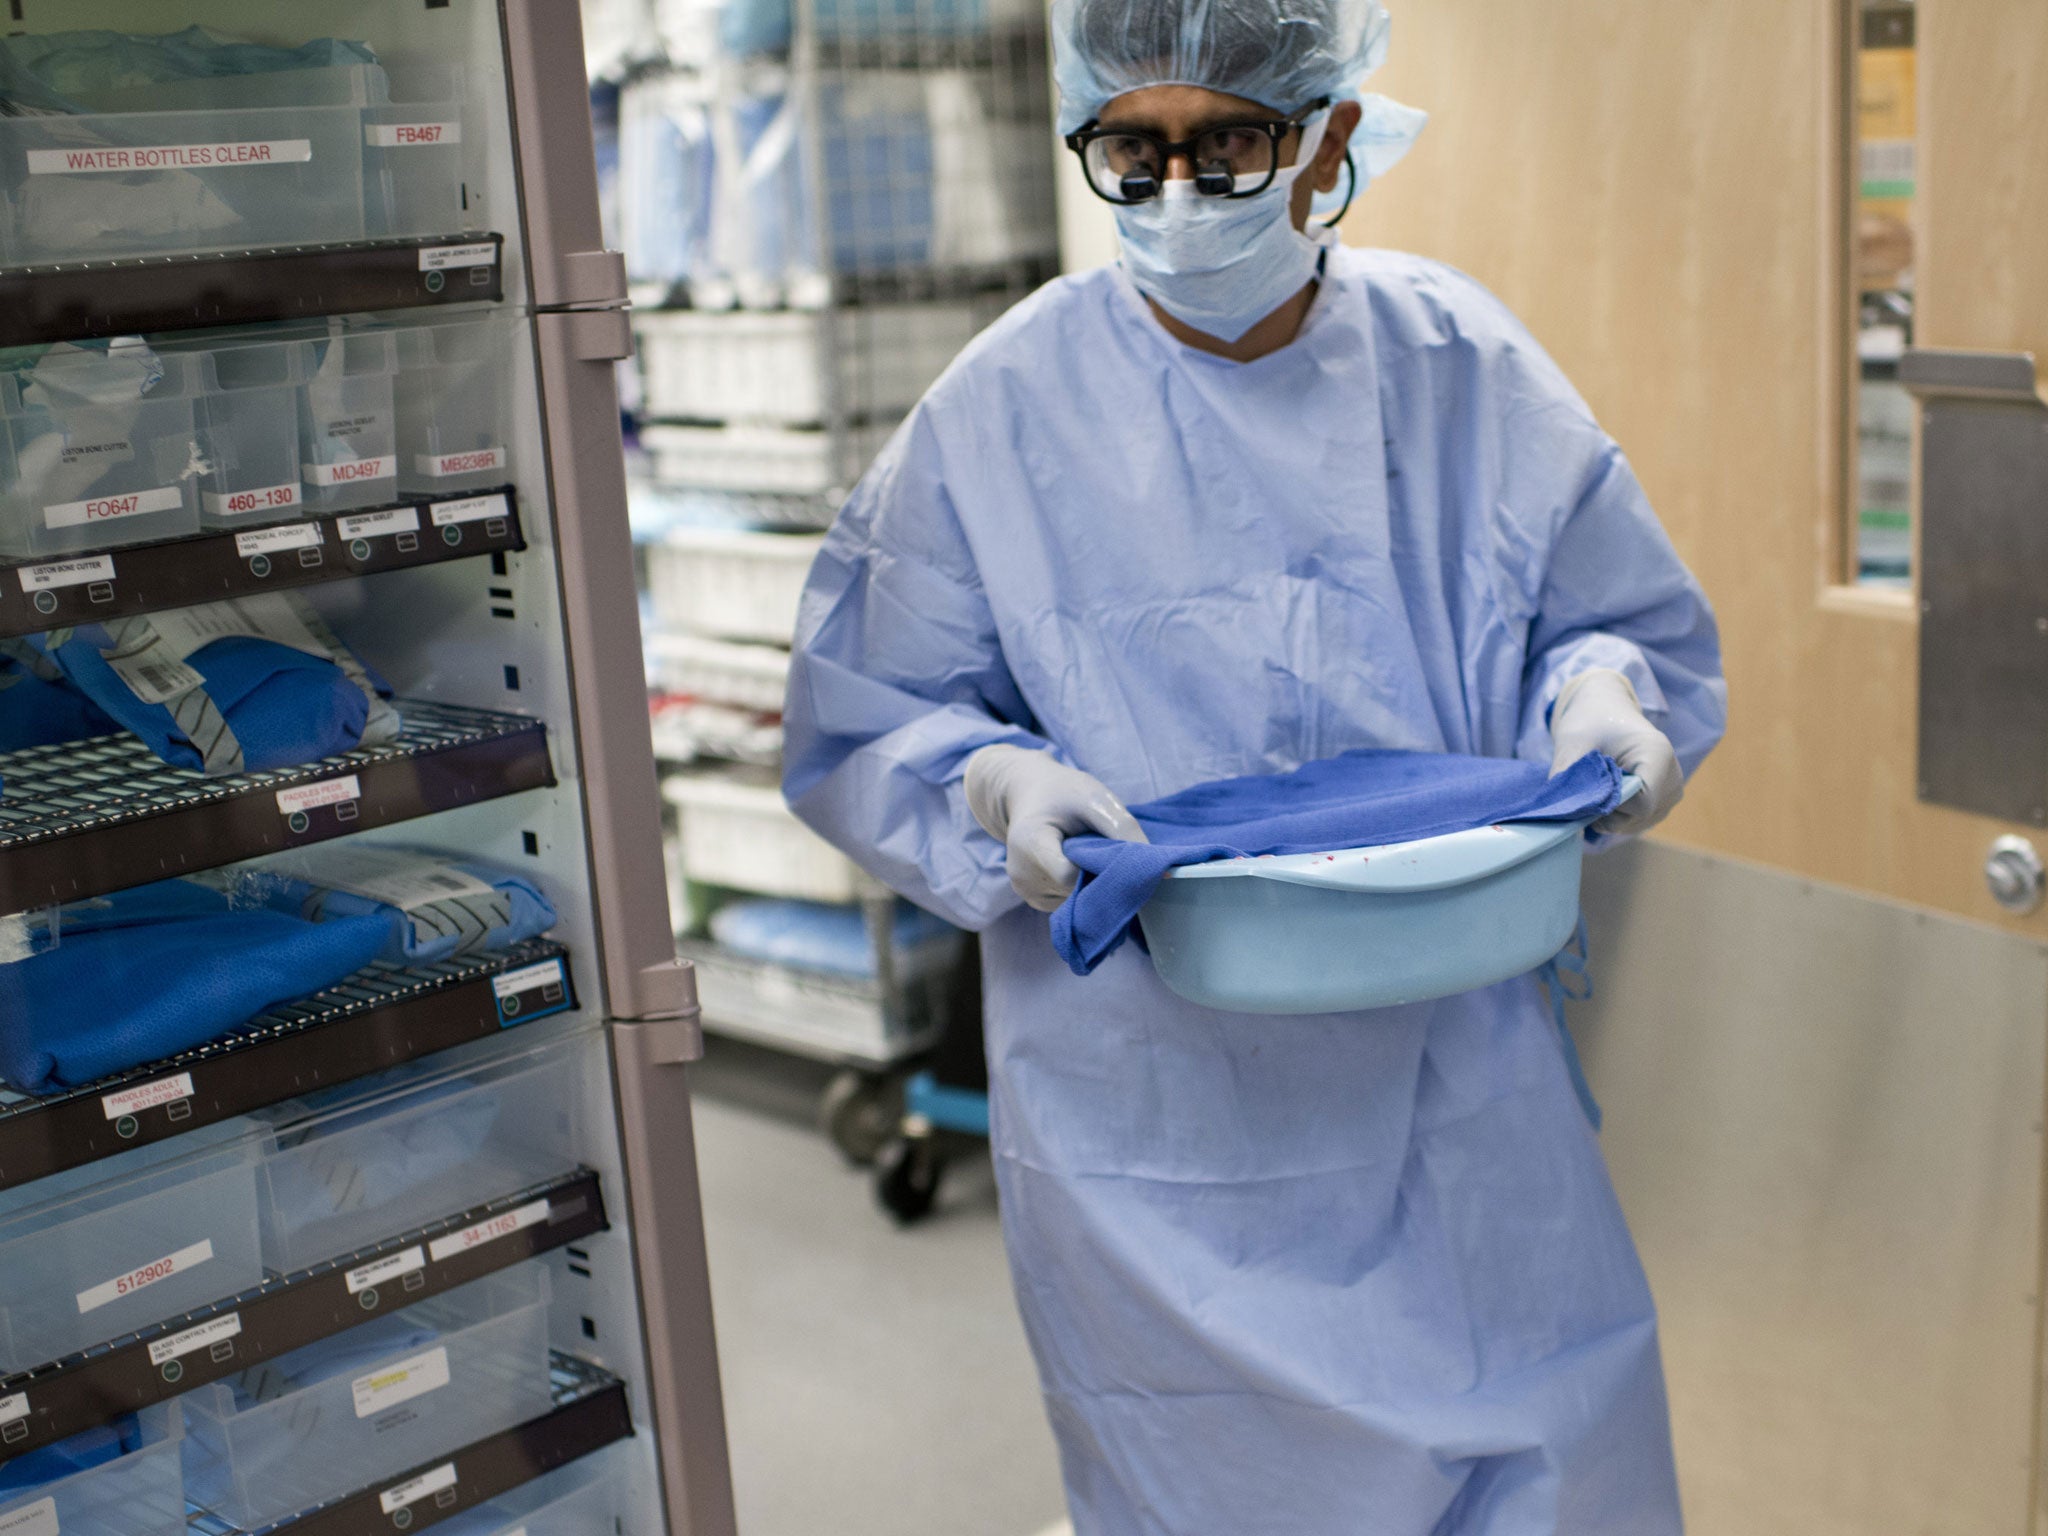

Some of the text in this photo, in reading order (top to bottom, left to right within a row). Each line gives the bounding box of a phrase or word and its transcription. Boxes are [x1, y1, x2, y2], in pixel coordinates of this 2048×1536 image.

[395, 126, 442, 143] FB467
[66, 145, 271, 169] WATER BOTTLES CLEAR
[331, 461, 381, 481] MD497
[440, 452, 496, 473] MB238R
[228, 488, 293, 511] 460-130
[33, 560, 102, 576] LISTON BONE CUTTER
[283, 788, 320, 802] PADDLES
[111, 1079, 180, 1106] PADDLES ADULT
[462, 1215, 517, 1246] 34-1163
[117, 1258, 174, 1294] 512902
